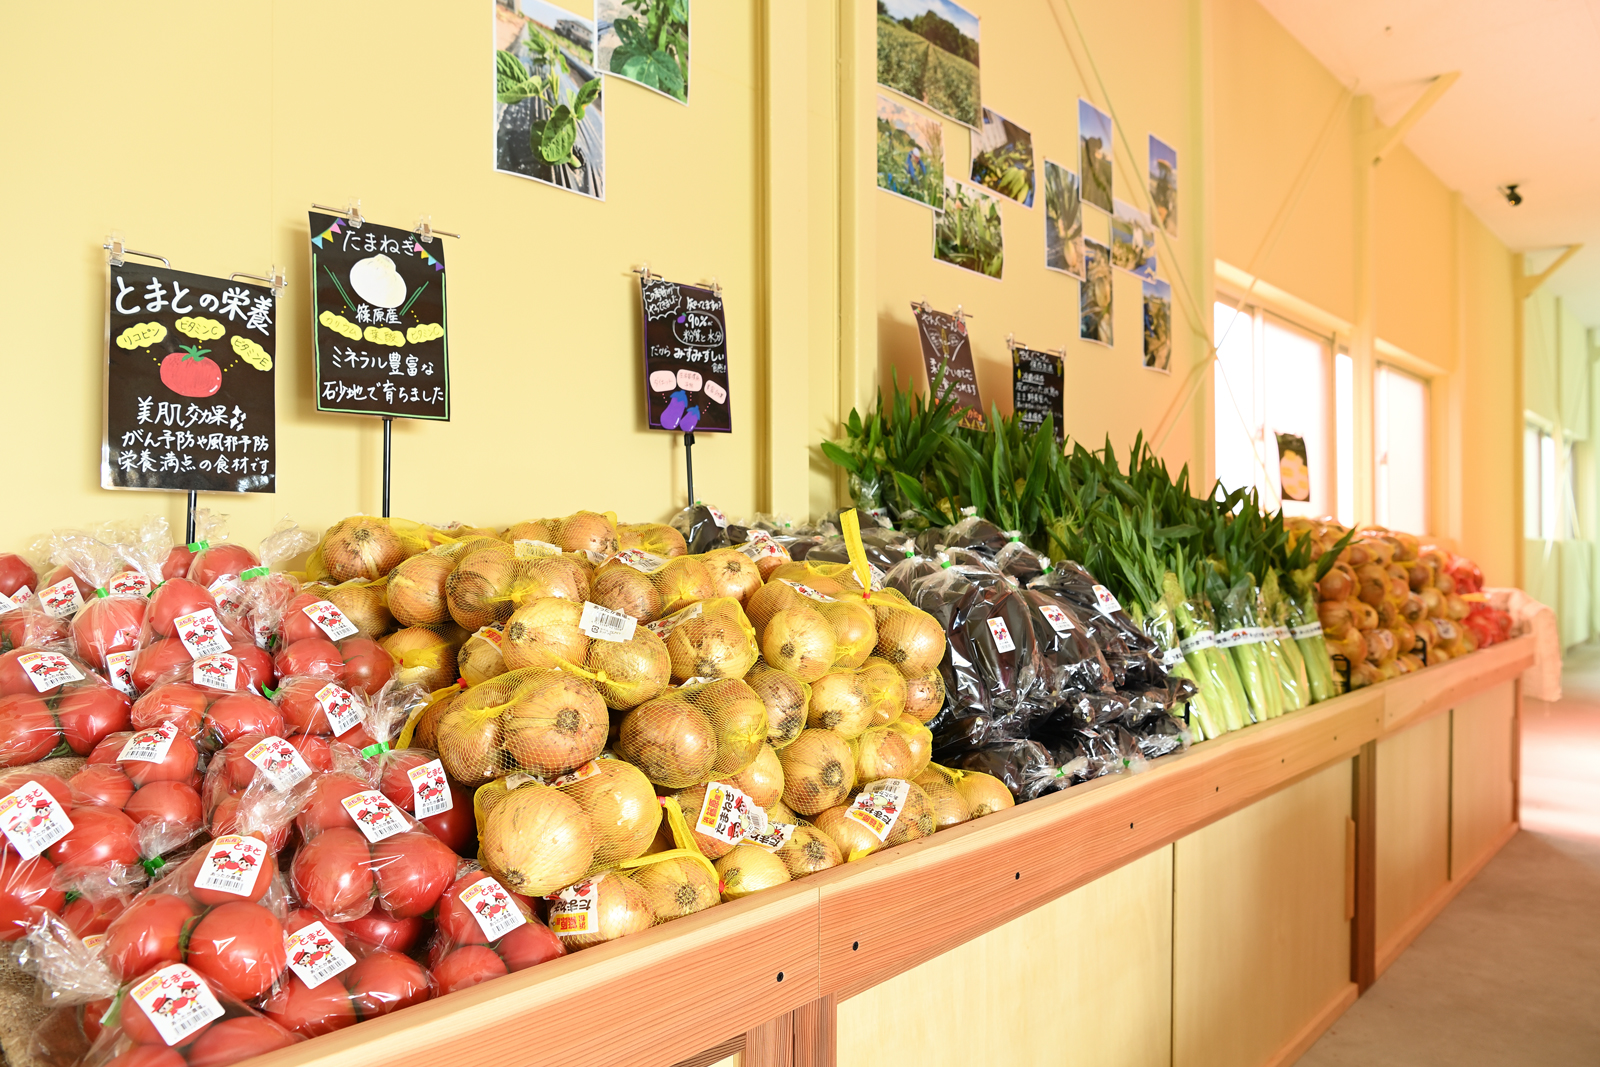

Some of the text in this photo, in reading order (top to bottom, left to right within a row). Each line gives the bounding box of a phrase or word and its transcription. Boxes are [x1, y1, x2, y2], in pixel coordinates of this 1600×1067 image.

[342, 230, 414, 257] たまねぎ
[115, 276, 273, 336] とまとの栄養
[355, 303, 402, 325] 篠原産
[123, 328, 160, 345] リコピン
[332, 345, 434, 376] ミネラル豊富な
[322, 379, 444, 405] 砂地で育ちました
[136, 396, 228, 427] 美肌効果
[121, 429, 269, 453] がん予防や風邪予防
[117, 449, 270, 474] 栄養満点の食材です
[54, 583, 73, 595] とまと
[320, 604, 335, 613] とまと
[192, 615, 214, 627] とまと
[266, 739, 287, 754] とまと
[427, 767, 443, 779] とまと
[16, 788, 43, 809] とまと
[364, 794, 385, 806] とまと
[715, 790, 735, 834] たまねぎ
[233, 843, 262, 856] とまと
[481, 883, 501, 896] とまと
[300, 929, 325, 945] とまと
[161, 970, 192, 989] とまと
